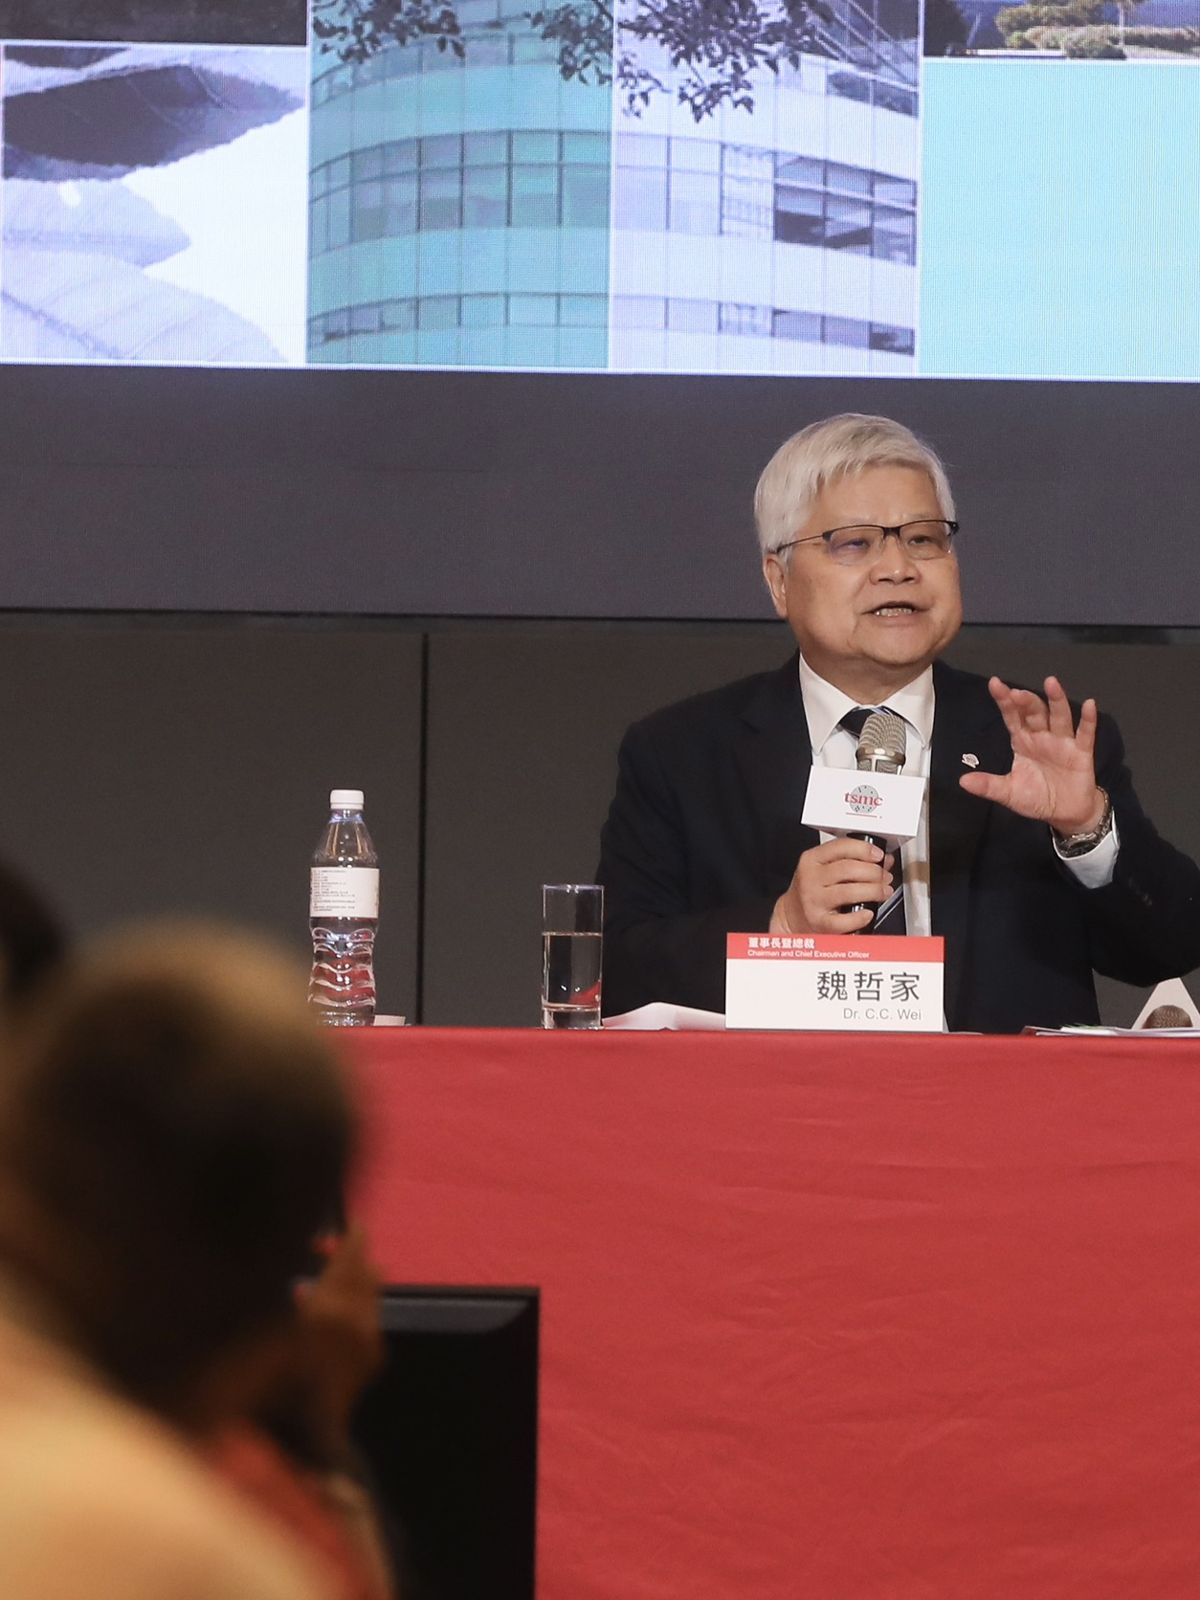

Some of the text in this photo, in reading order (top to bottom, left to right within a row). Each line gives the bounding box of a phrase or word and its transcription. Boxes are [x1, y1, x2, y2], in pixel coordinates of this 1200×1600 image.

[844, 792, 884, 807] tsmc
[747, 949, 780, 957] Chairman
[795, 949, 813, 958] Chief
[814, 950, 847, 959] Executive
[847, 951, 870, 959] Officer
[817, 970, 920, 1002] 魏哲家
[843, 1007, 922, 1021] Dr. C.C. Wei
